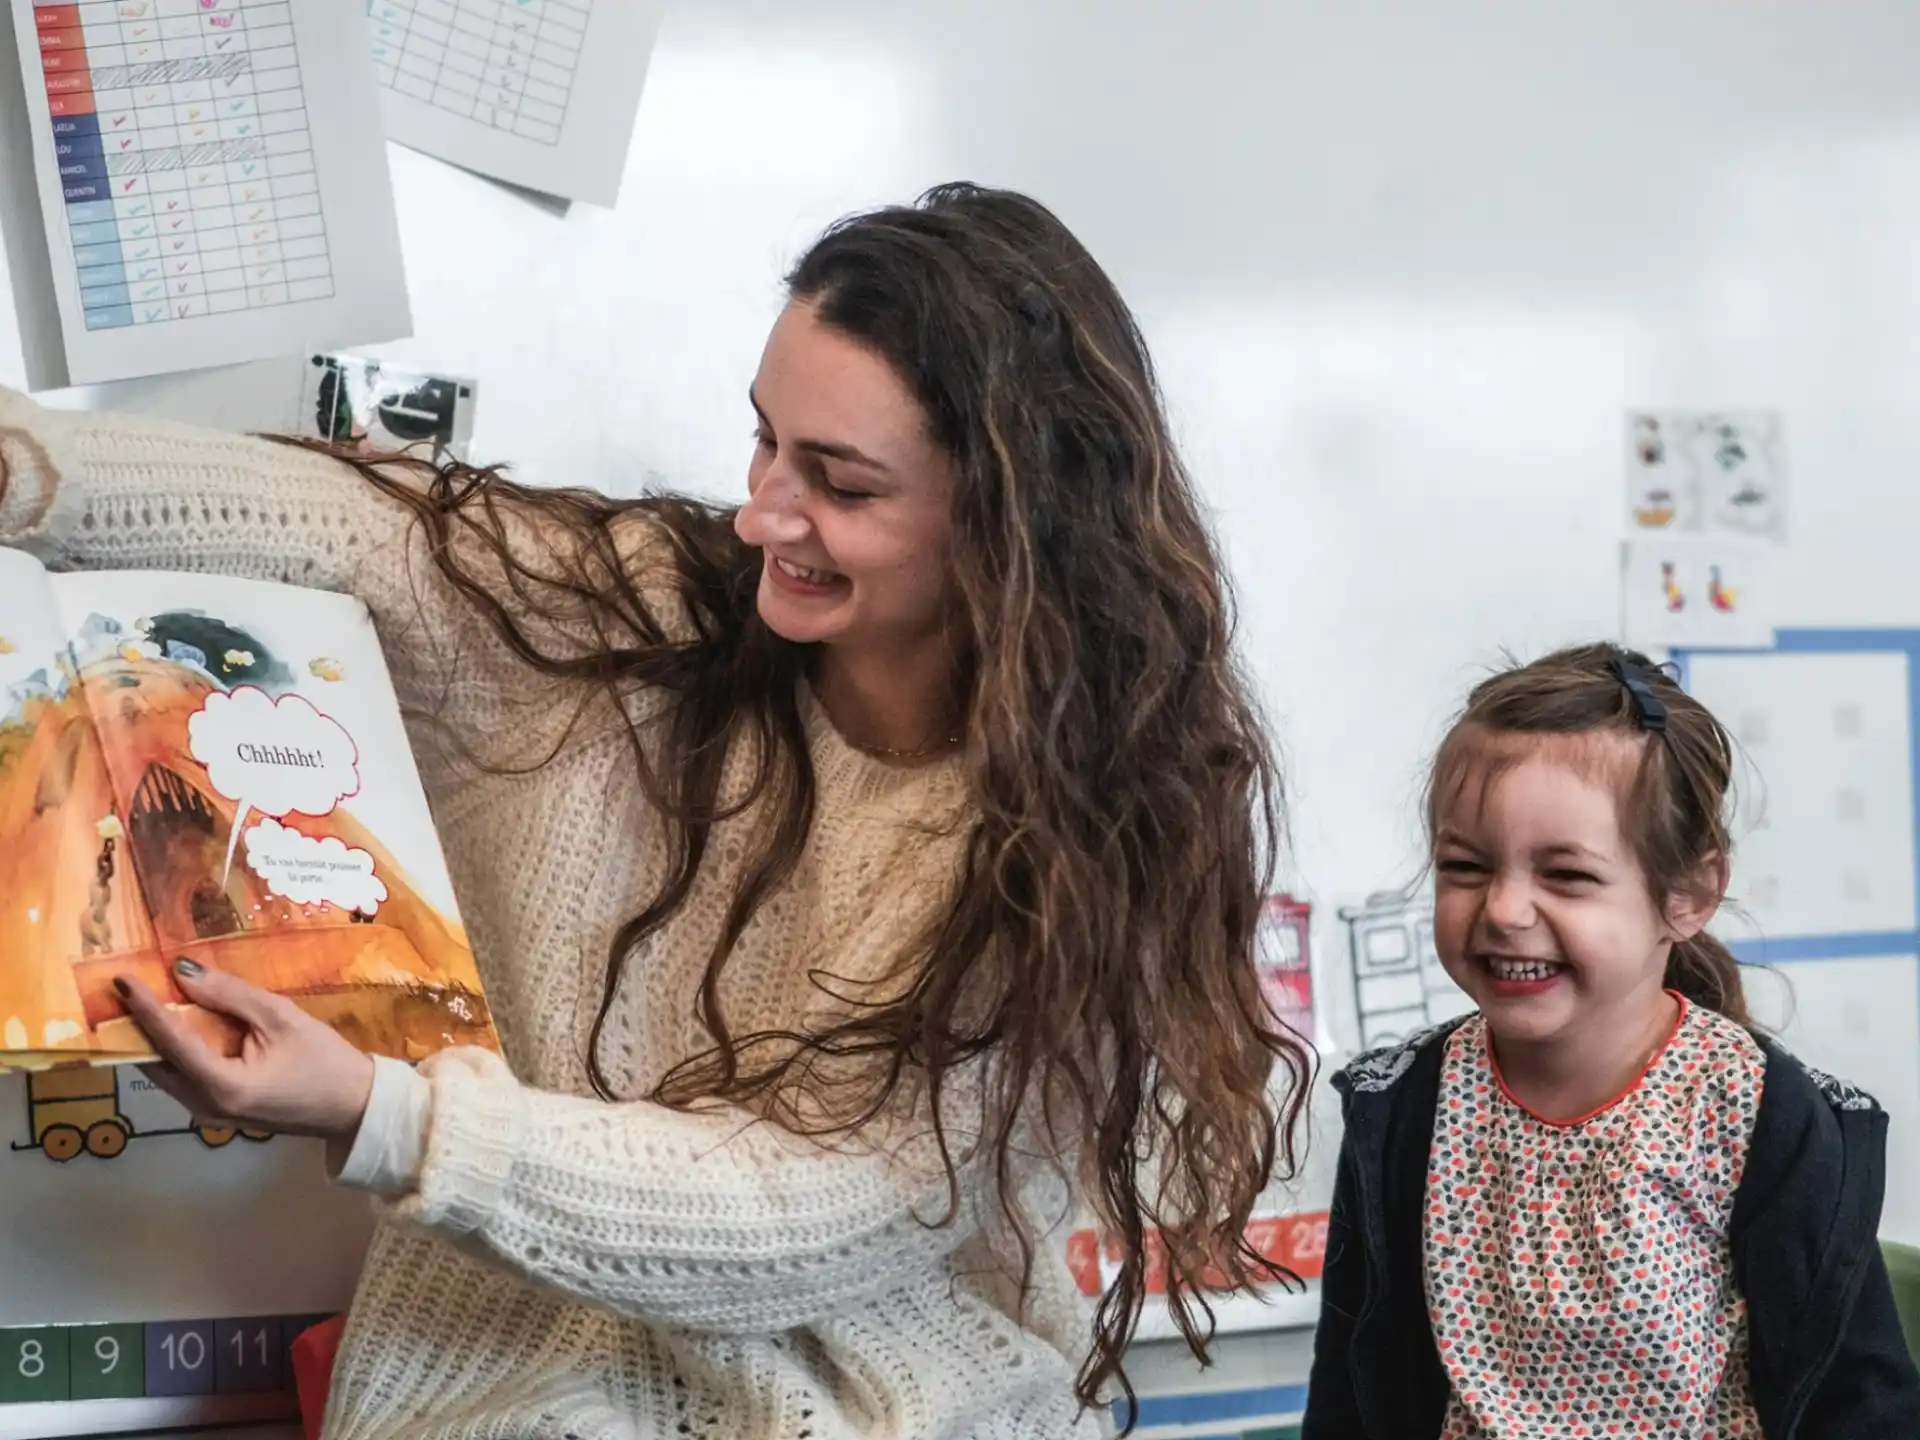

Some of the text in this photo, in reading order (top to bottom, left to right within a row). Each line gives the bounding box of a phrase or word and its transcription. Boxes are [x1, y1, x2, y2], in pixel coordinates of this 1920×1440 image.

[237, 742, 324, 769] Chhhhht!
[262, 854, 277, 867] Tu
[19, 1328, 267, 1377] 8 9 10 11
